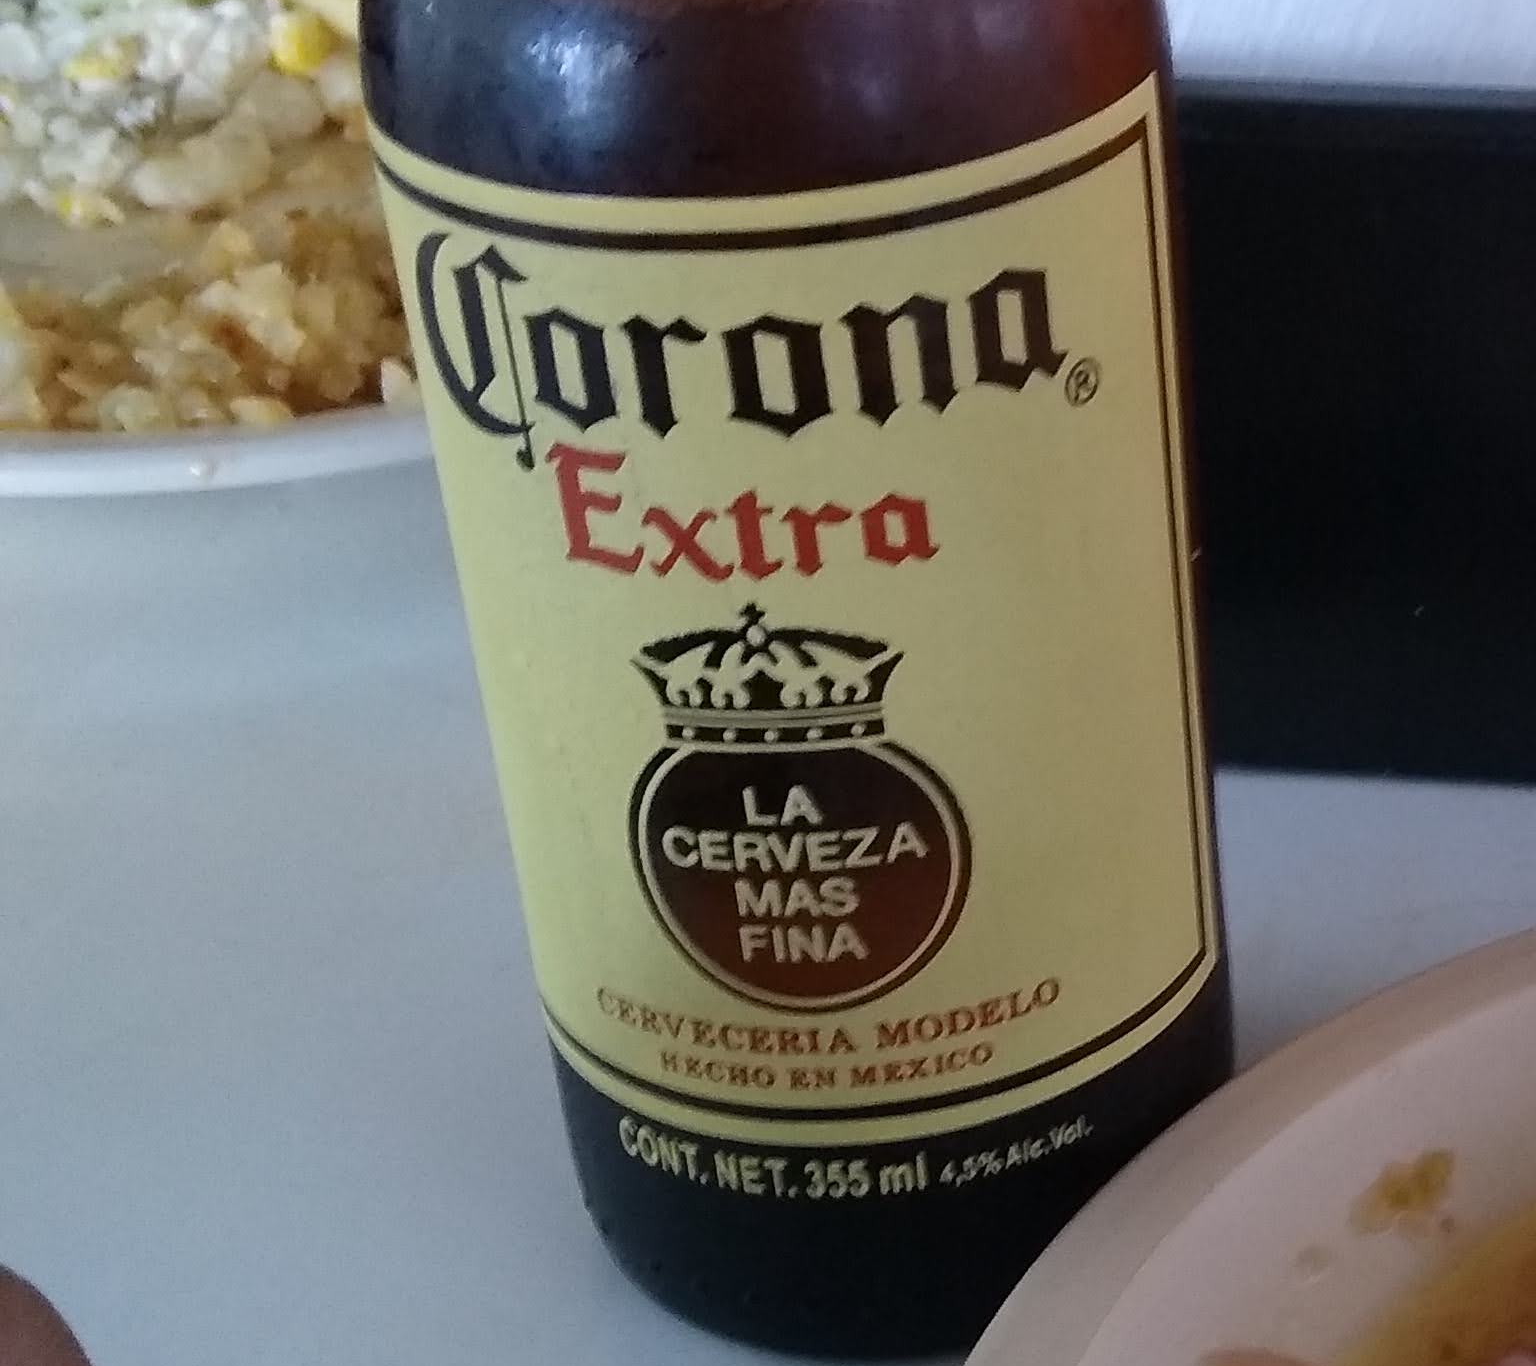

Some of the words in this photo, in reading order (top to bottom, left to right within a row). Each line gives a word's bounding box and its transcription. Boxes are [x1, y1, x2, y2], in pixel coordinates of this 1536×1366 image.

[417, 232, 1069, 469] Corona
[545, 442, 939, 582] Extra
[742, 784, 822, 827] LA
[661, 826, 929, 873] CERVEZA
[734, 876, 860, 919] MAS
[738, 921, 869, 964] FINA
[597, 986, 857, 1055] CERVECERIA
[874, 977, 1061, 1051] MODELO
[659, 1050, 776, 1089] HECHO
[788, 1066, 837, 1090] EN
[849, 1042, 994, 1087] MEXICO
[618, 1115, 709, 1186] CONT.
[712, 1150, 798, 1200] NET.
[803, 1158, 870, 1200] 355
[879, 1150, 928, 1195] ml
